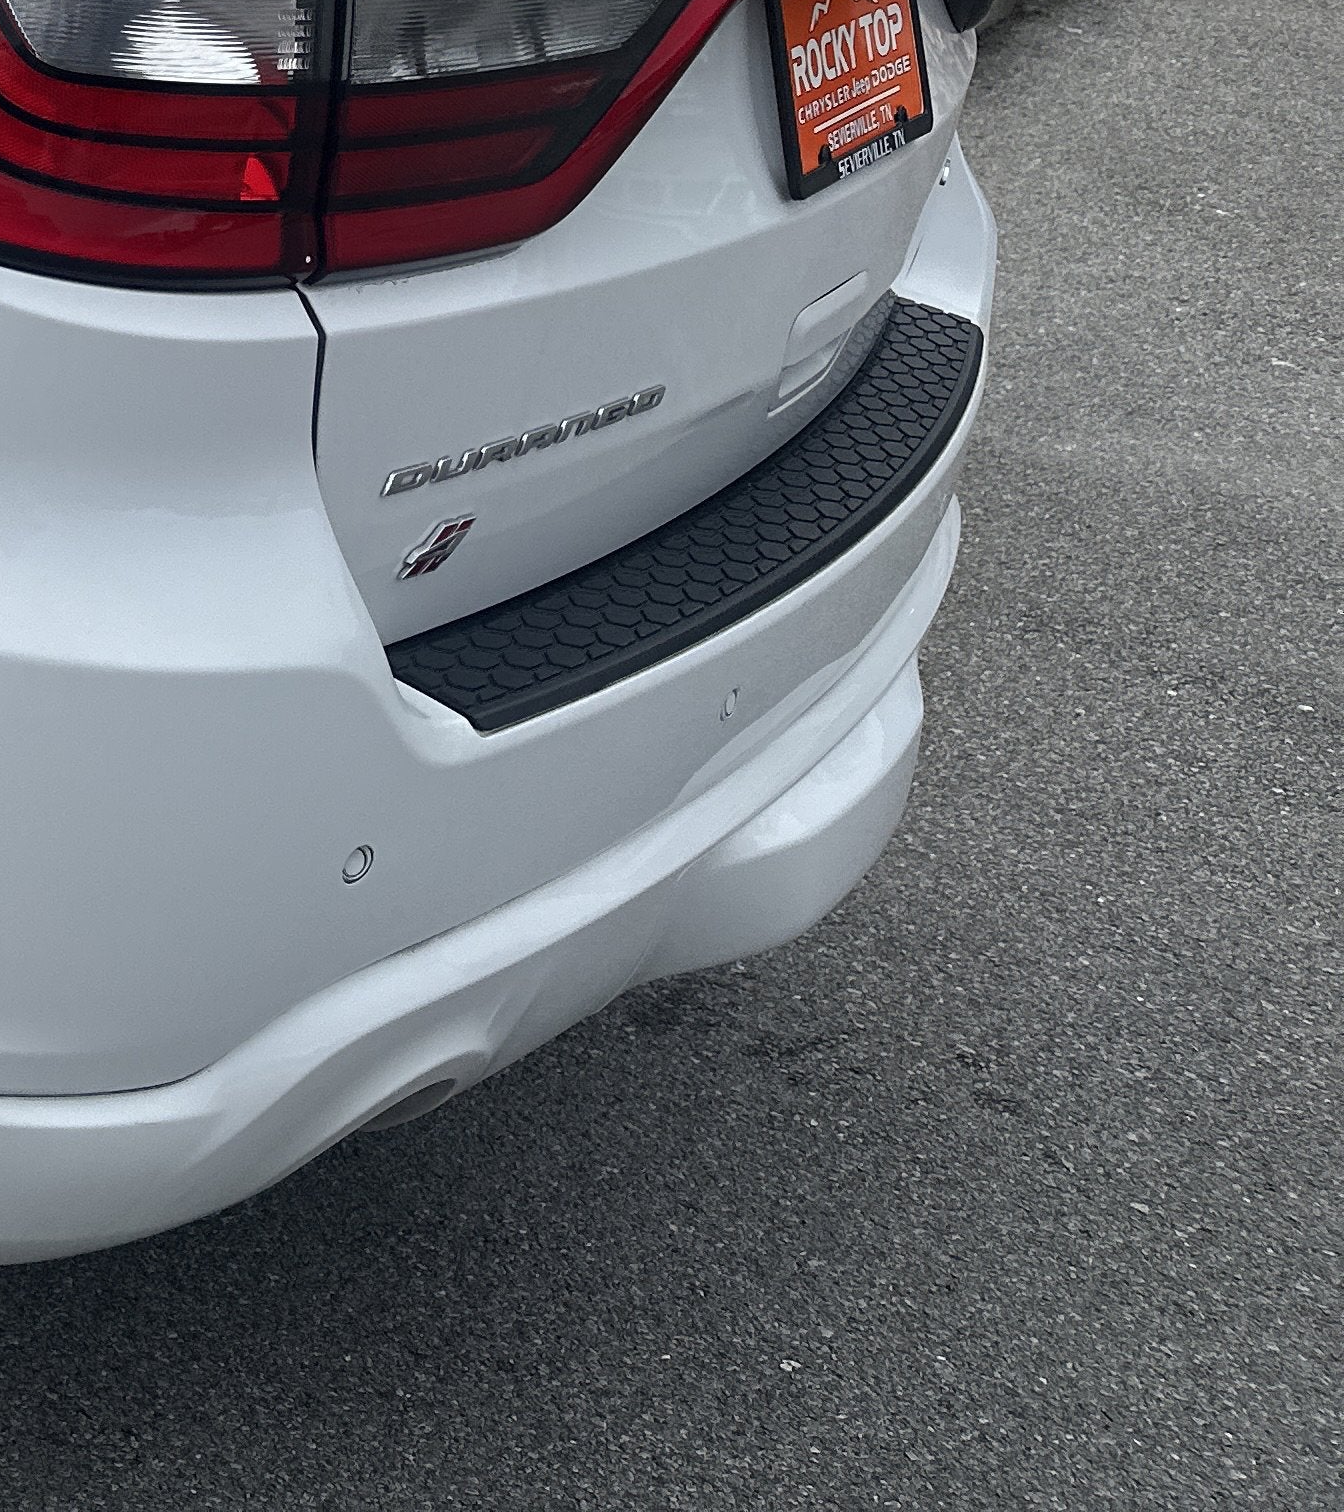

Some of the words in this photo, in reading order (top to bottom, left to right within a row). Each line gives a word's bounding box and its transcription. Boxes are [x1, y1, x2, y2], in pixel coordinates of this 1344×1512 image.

[791, 19, 856, 96] ROCKY
[859, 3, 903, 62] TOP
[798, 85, 850, 124] CHRYSLER
[872, 55, 912, 85] DODGE
[880, 103, 893, 124] TN
[893, 127, 906, 146] TN
[379, 384, 667, 499] DURANGO
